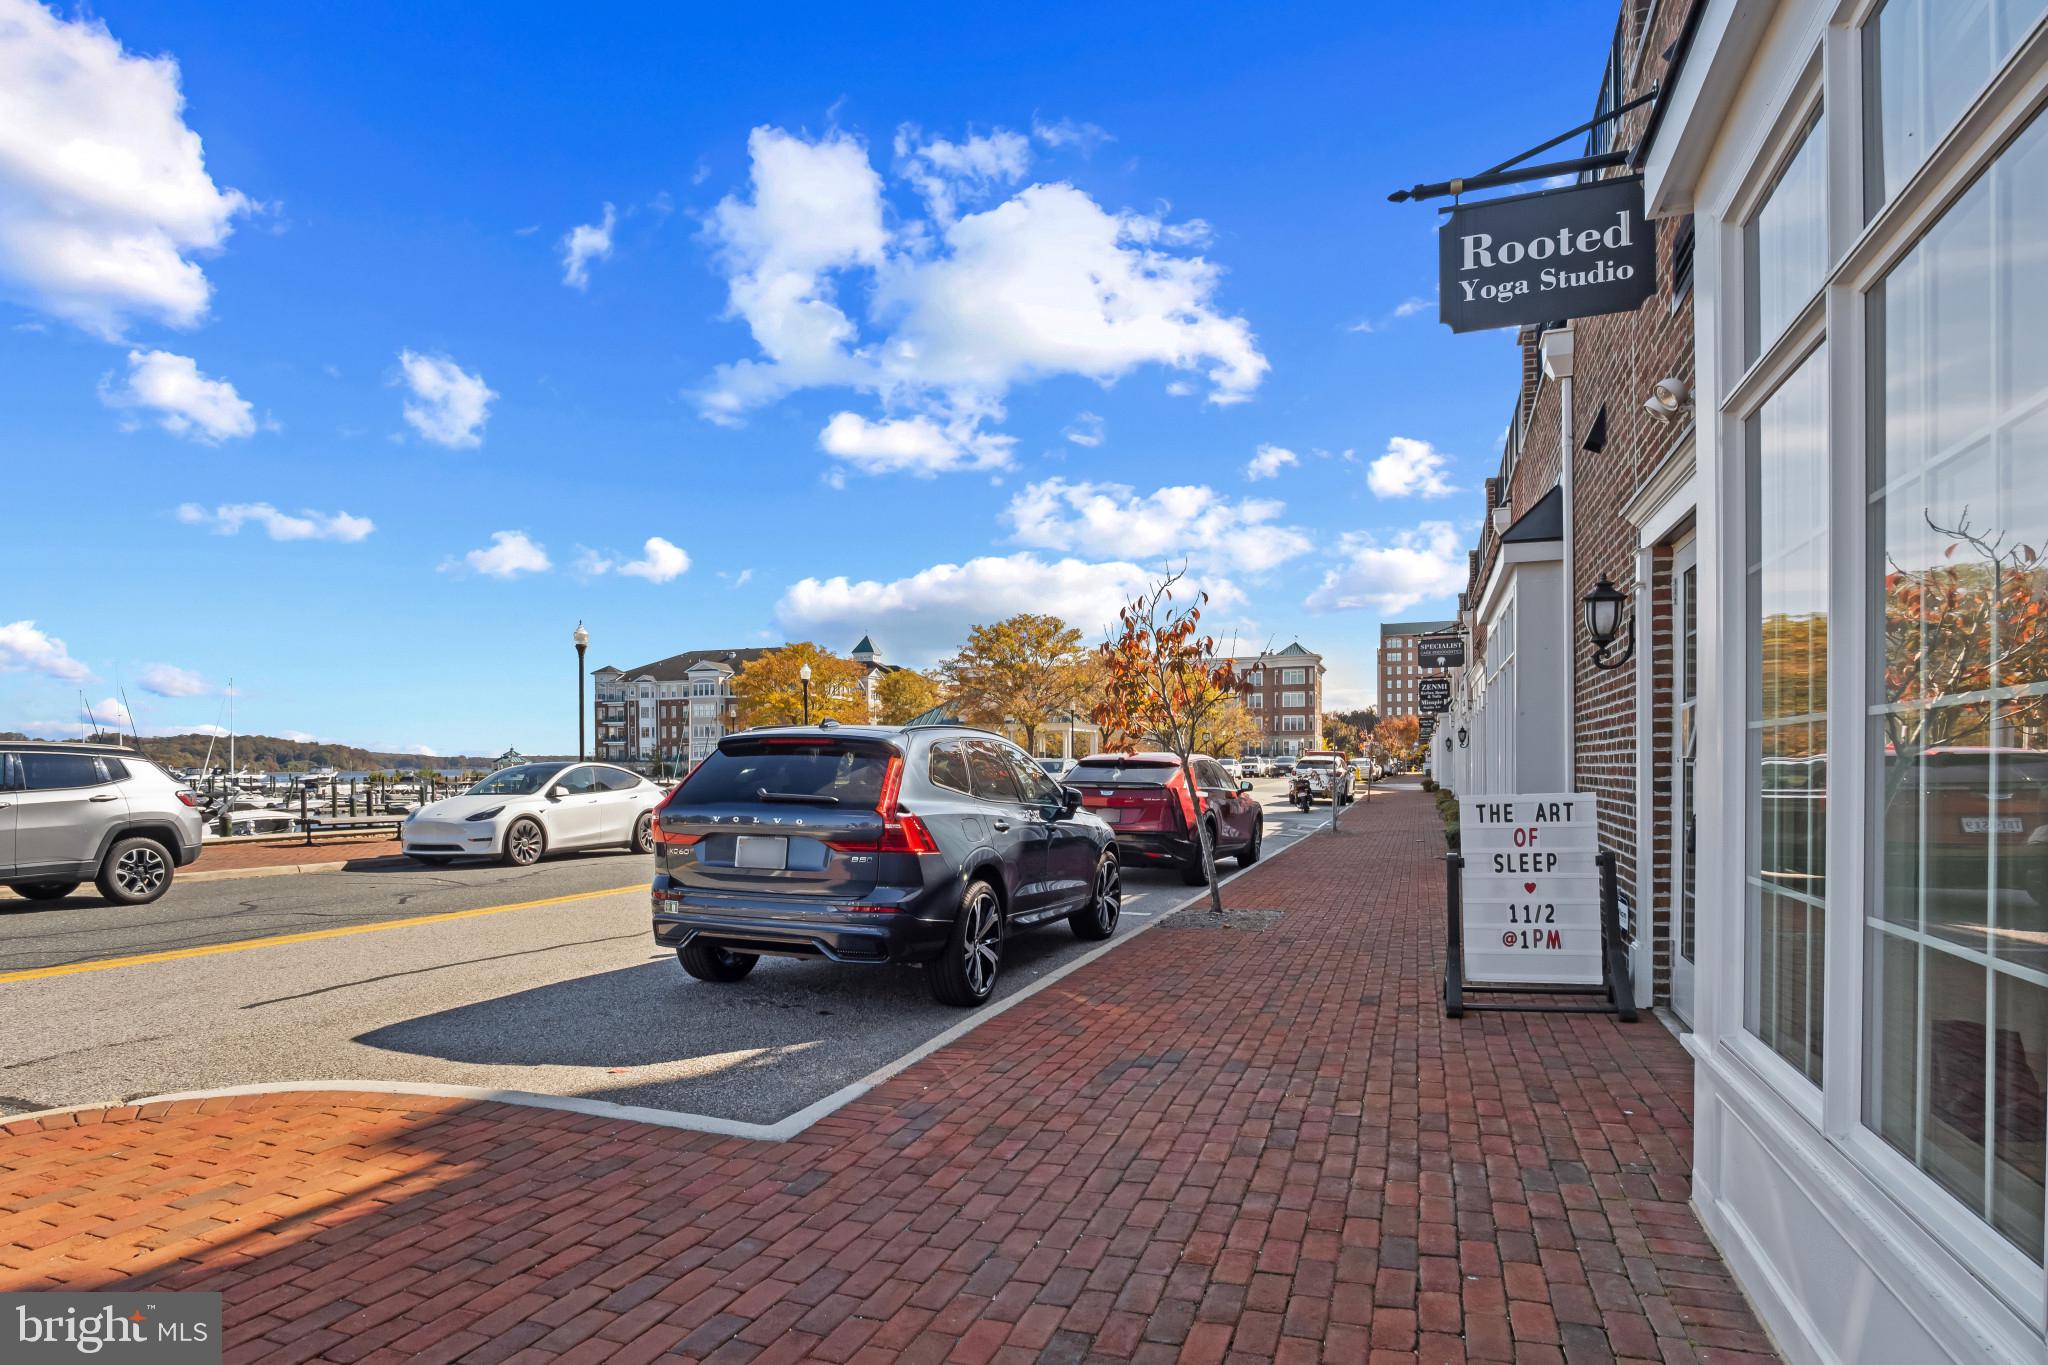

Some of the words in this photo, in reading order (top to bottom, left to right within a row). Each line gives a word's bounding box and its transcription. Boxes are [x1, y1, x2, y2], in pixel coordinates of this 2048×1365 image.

[1459, 209, 1634, 271] Rooted
[1458, 278, 1530, 303] Yoga
[1540, 260, 1634, 292] Studio
[1420, 642, 1463, 650] SPECIALIST
[1421, 683, 1448, 691] ZENMI
[712, 815, 804, 825] VOLVO
[1475, 803, 1514, 823] THE
[1535, 802, 1574, 822] ART
[1513, 827, 1539, 848] OF
[1493, 852, 1558, 873] SLEEP
[1509, 903, 1555, 924] 11/2
[1502, 928, 1562, 950] @1PM
